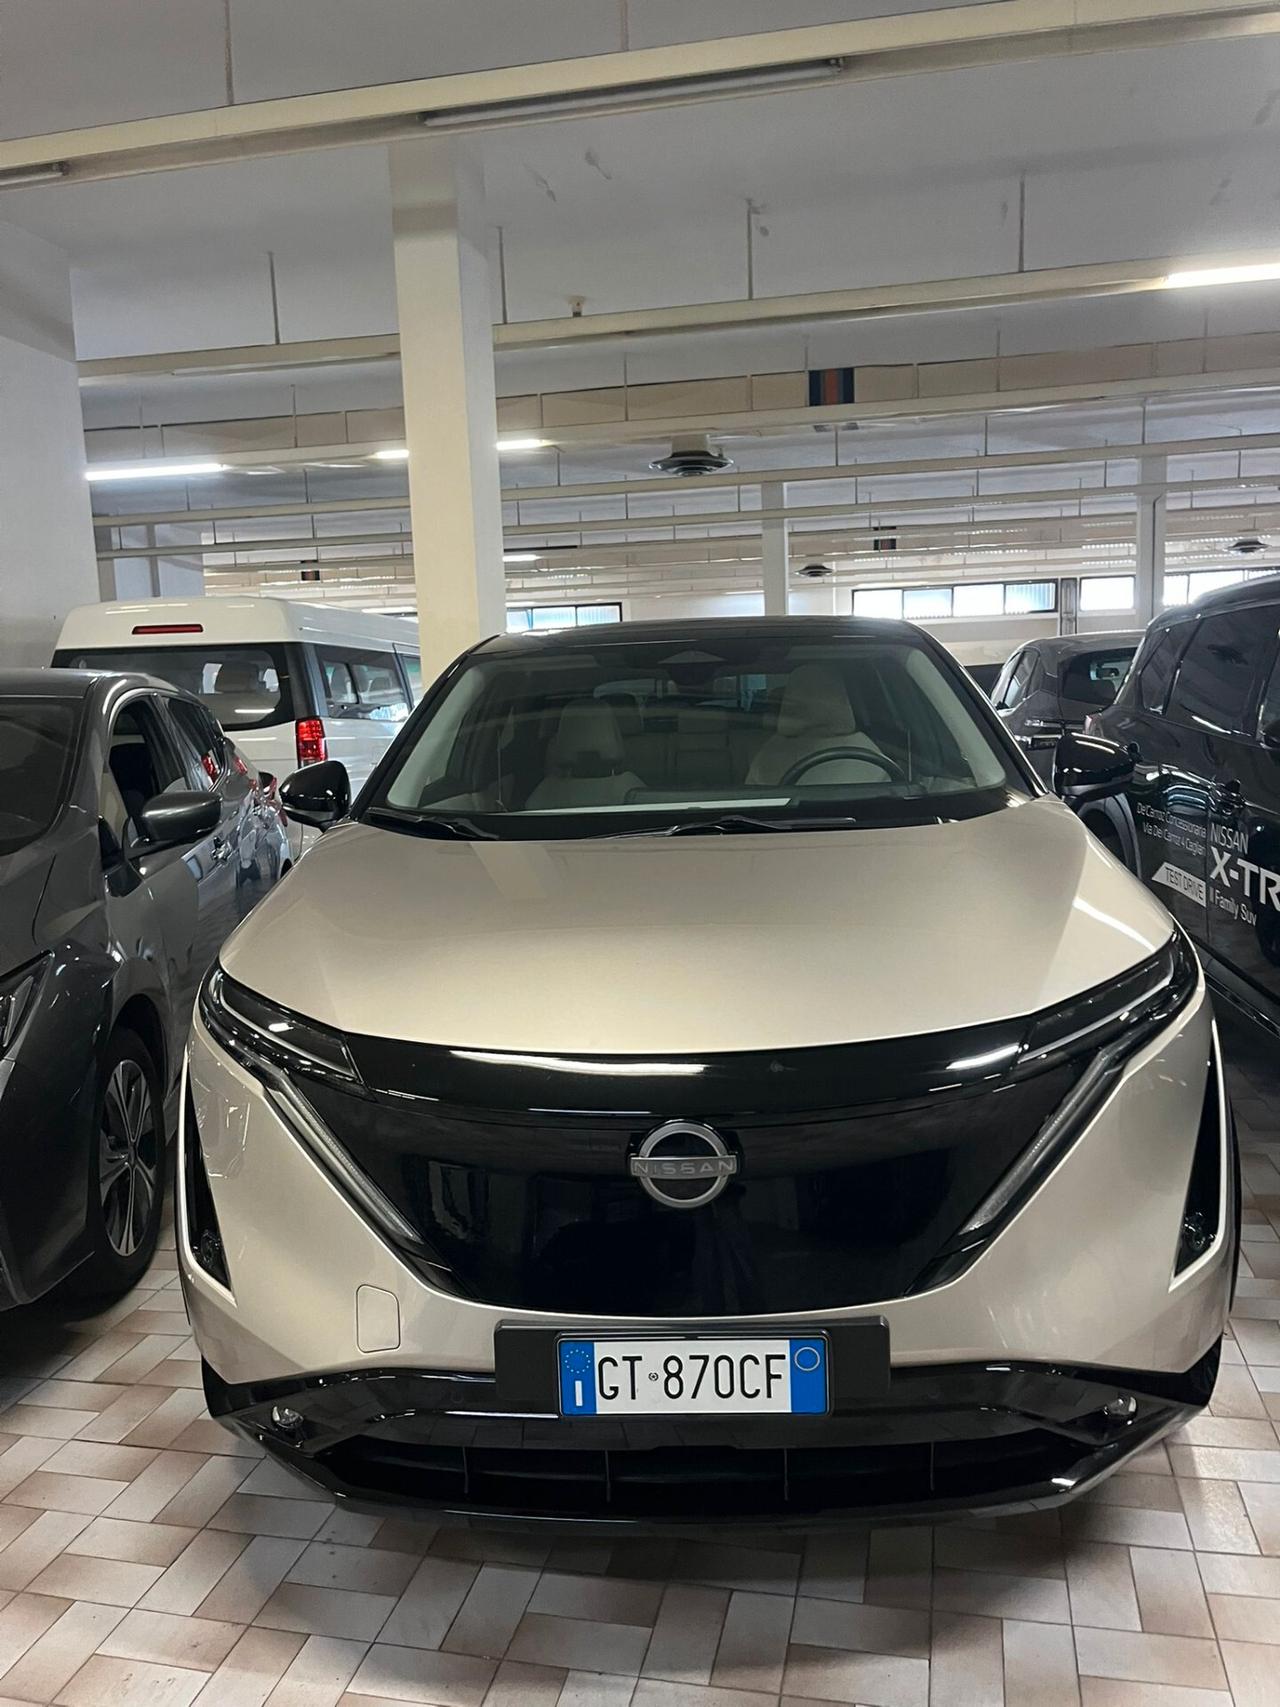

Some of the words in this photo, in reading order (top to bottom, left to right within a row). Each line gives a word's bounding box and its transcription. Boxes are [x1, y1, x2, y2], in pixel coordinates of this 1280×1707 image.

[1210, 822, 1249, 855] NISSAN
[1164, 865, 1181, 888] TEST
[1182, 872, 1205, 901] DRIVE
[1214, 888, 1239, 920] Family
[634, 1160, 733, 1175] NISSAN
[598, 1355, 643, 1400] GT
[662, 1354, 787, 1400] 870CF
